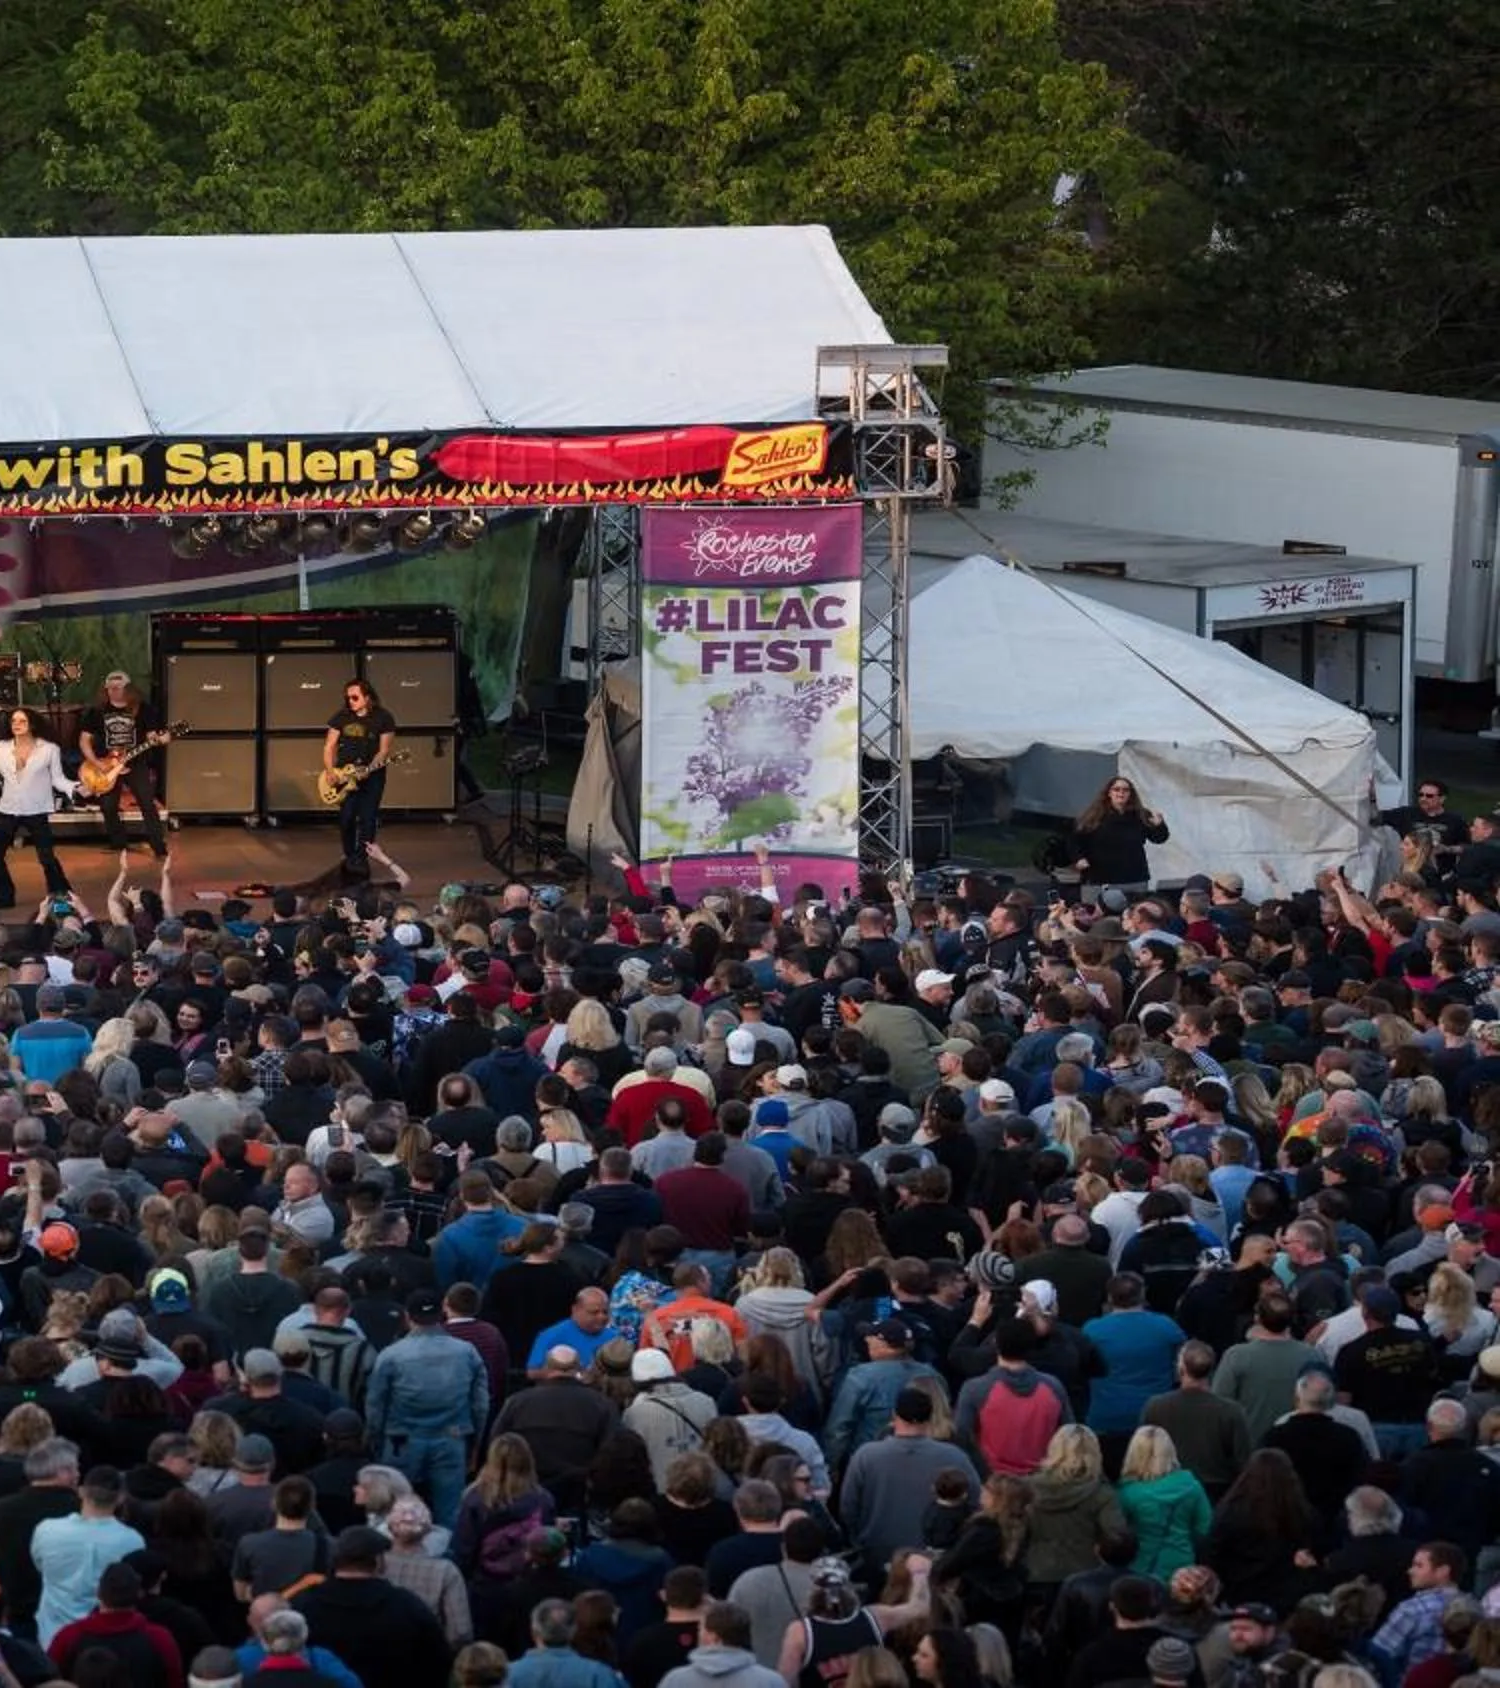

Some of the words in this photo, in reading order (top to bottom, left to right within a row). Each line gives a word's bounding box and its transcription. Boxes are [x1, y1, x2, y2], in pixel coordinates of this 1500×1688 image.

[165, 437, 420, 485] Sahlen's
[732, 435, 819, 475] Sahlen's
[698, 529, 816, 556] Rochester
[739, 552, 817, 577] Events
[656, 596, 847, 632] #LILAC
[701, 639, 832, 674] FEST
